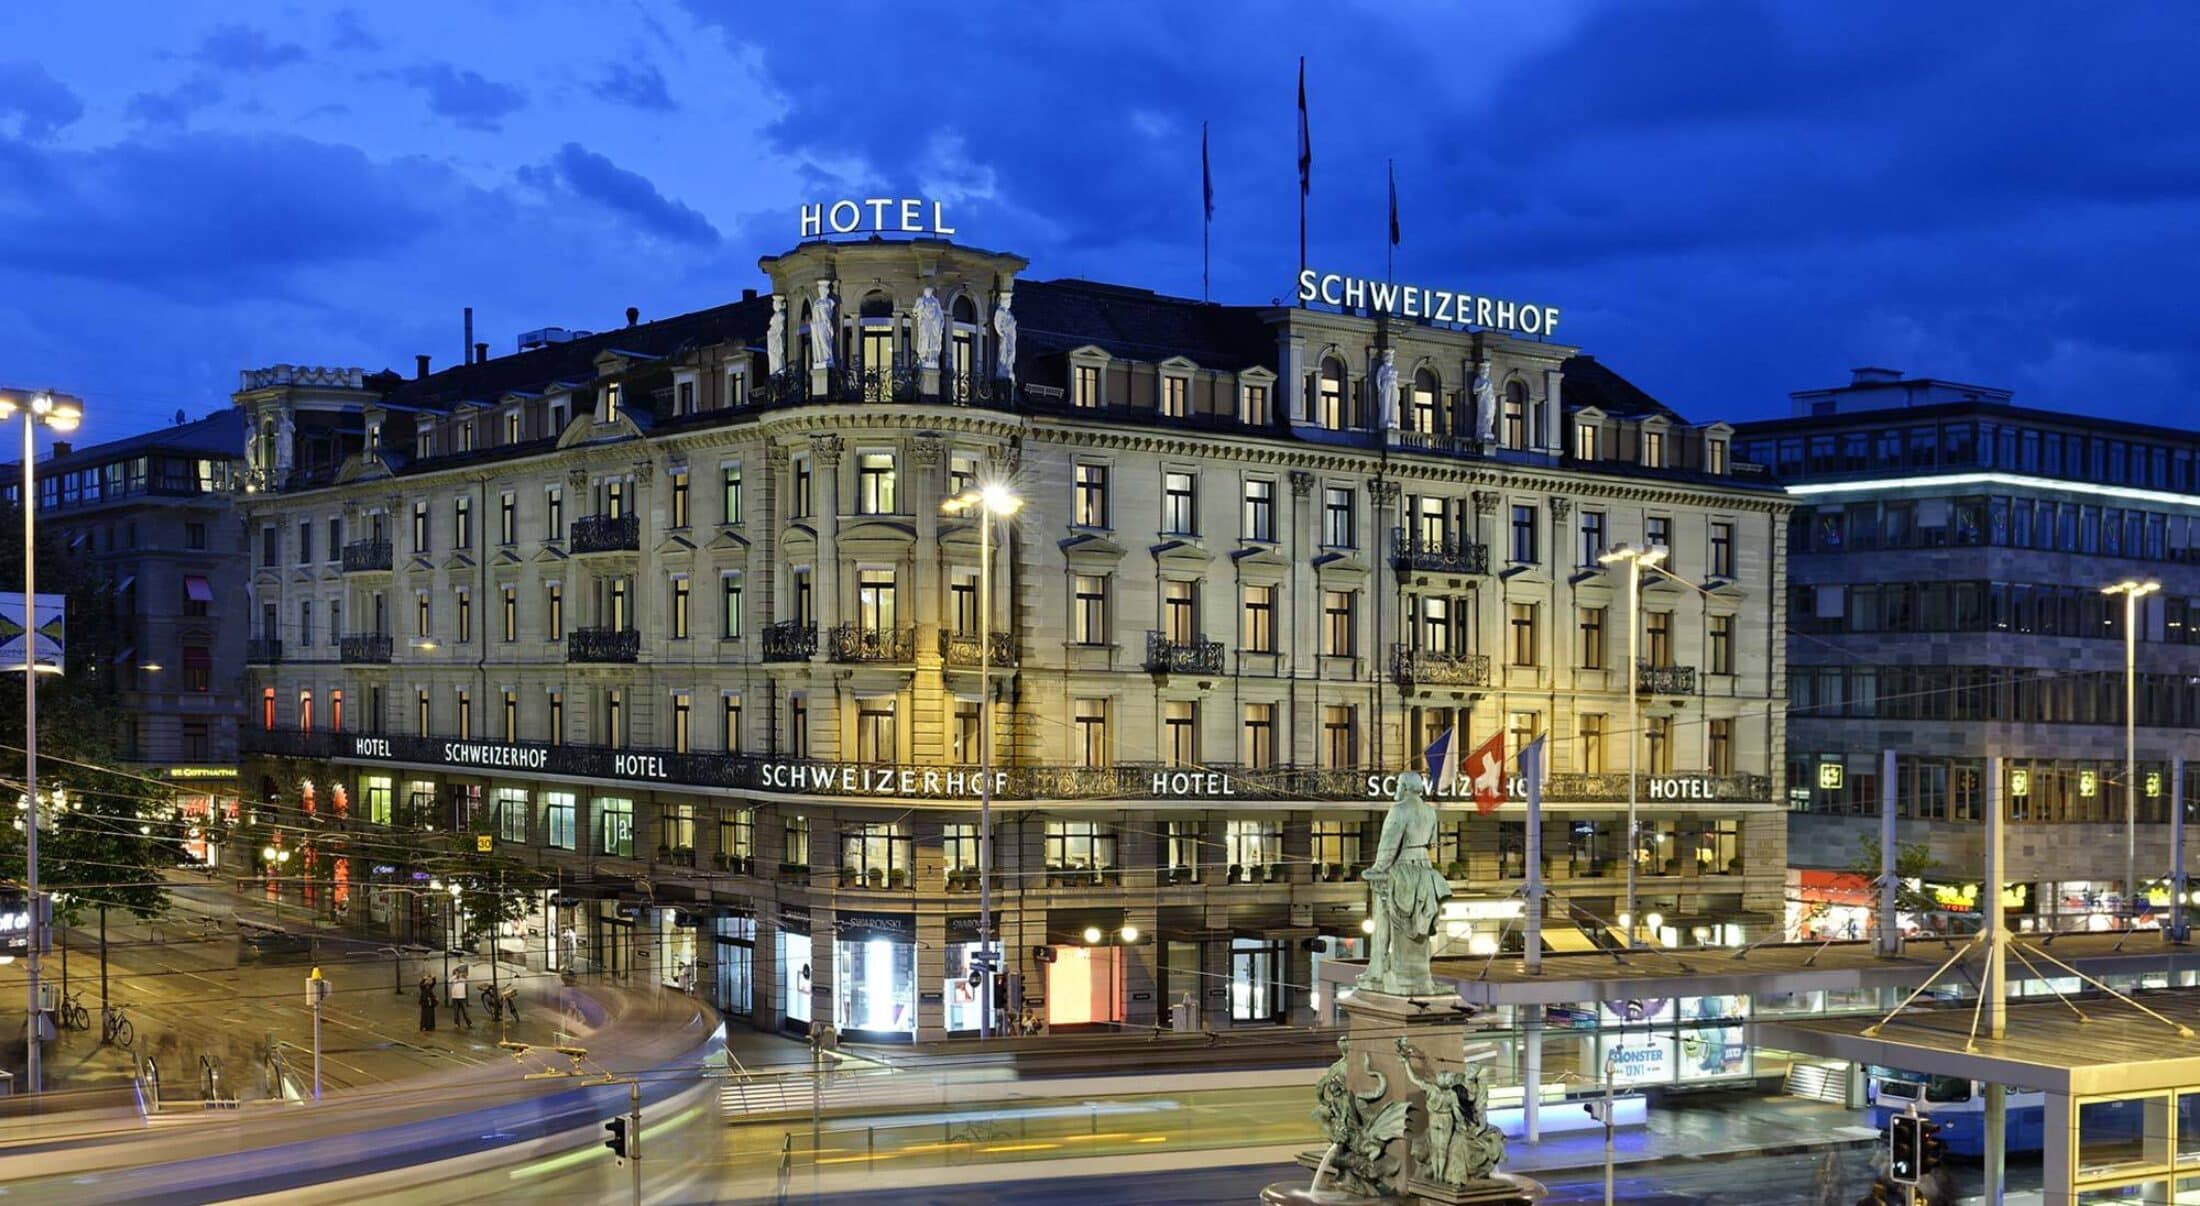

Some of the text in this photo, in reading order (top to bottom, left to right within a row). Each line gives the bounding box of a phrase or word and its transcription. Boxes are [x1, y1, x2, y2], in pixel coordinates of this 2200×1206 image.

[801, 199, 956, 236] HOTEL
[1298, 270, 1559, 335] SCHWEIZERHOF
[356, 738, 392, 757] HOTEL
[445, 743, 548, 768] SCHWEIZERHOF
[615, 755, 668, 777] HOTEL
[762, 764, 1008, 795] SCHWEIZERHOF
[1152, 773, 1235, 794] HOTEL
[1367, 775, 1543, 797] SCWIZHO
[1650, 779, 1714, 798] HOTEL
[479, 840, 491, 849] 30
